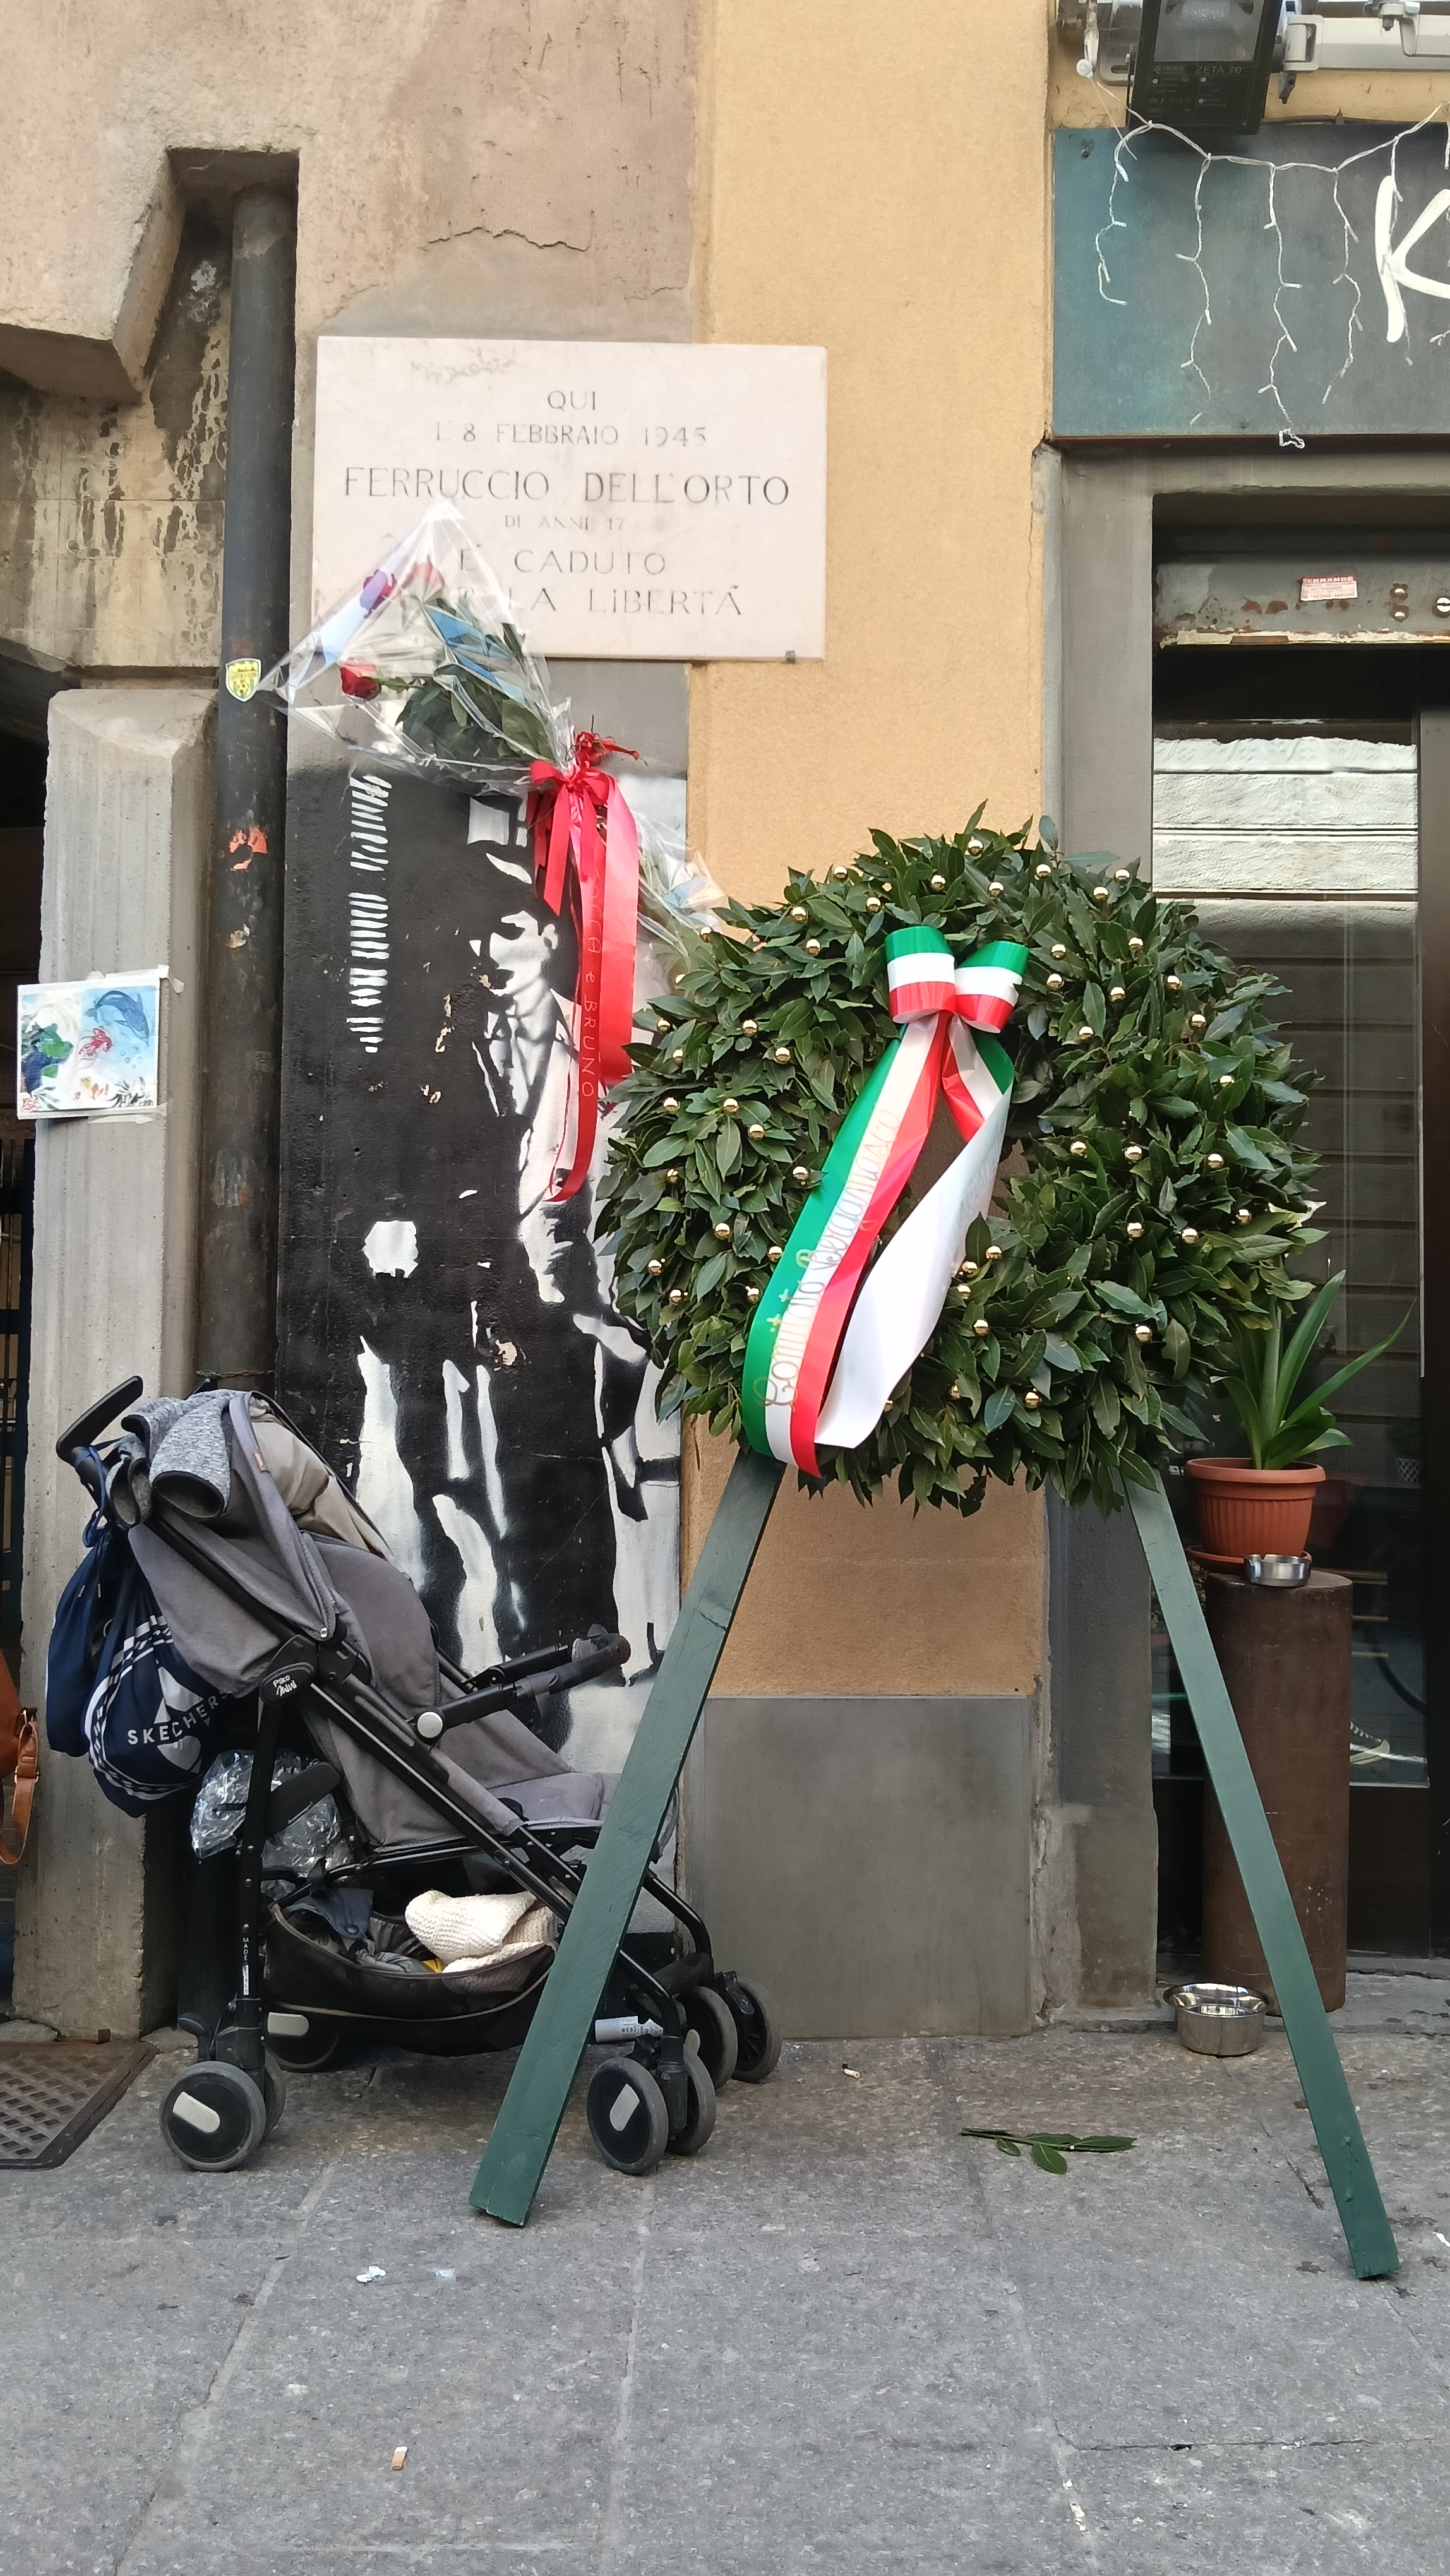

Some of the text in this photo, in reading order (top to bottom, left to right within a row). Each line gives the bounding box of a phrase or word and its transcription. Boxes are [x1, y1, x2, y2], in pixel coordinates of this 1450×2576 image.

[1195, 66, 1225, 74] ZETA
[1228, 66, 1242, 74] 70
[548, 390, 596, 411] QUI
[496, 424, 618, 445] FEBBRAIO
[644, 426, 706, 447] 1945
[345, 467, 788, 505] FERRUCCIO DELL'ORTO
[505, 515, 625, 530] DI ANNI 17
[514, 549, 666, 575] CADUTO
[508, 588, 558, 612] LA
[585, 972, 595, 983] e
[582, 994, 597, 1097] BRUNO
[752, 1109, 901, 1412] Comitato Bergamasco
